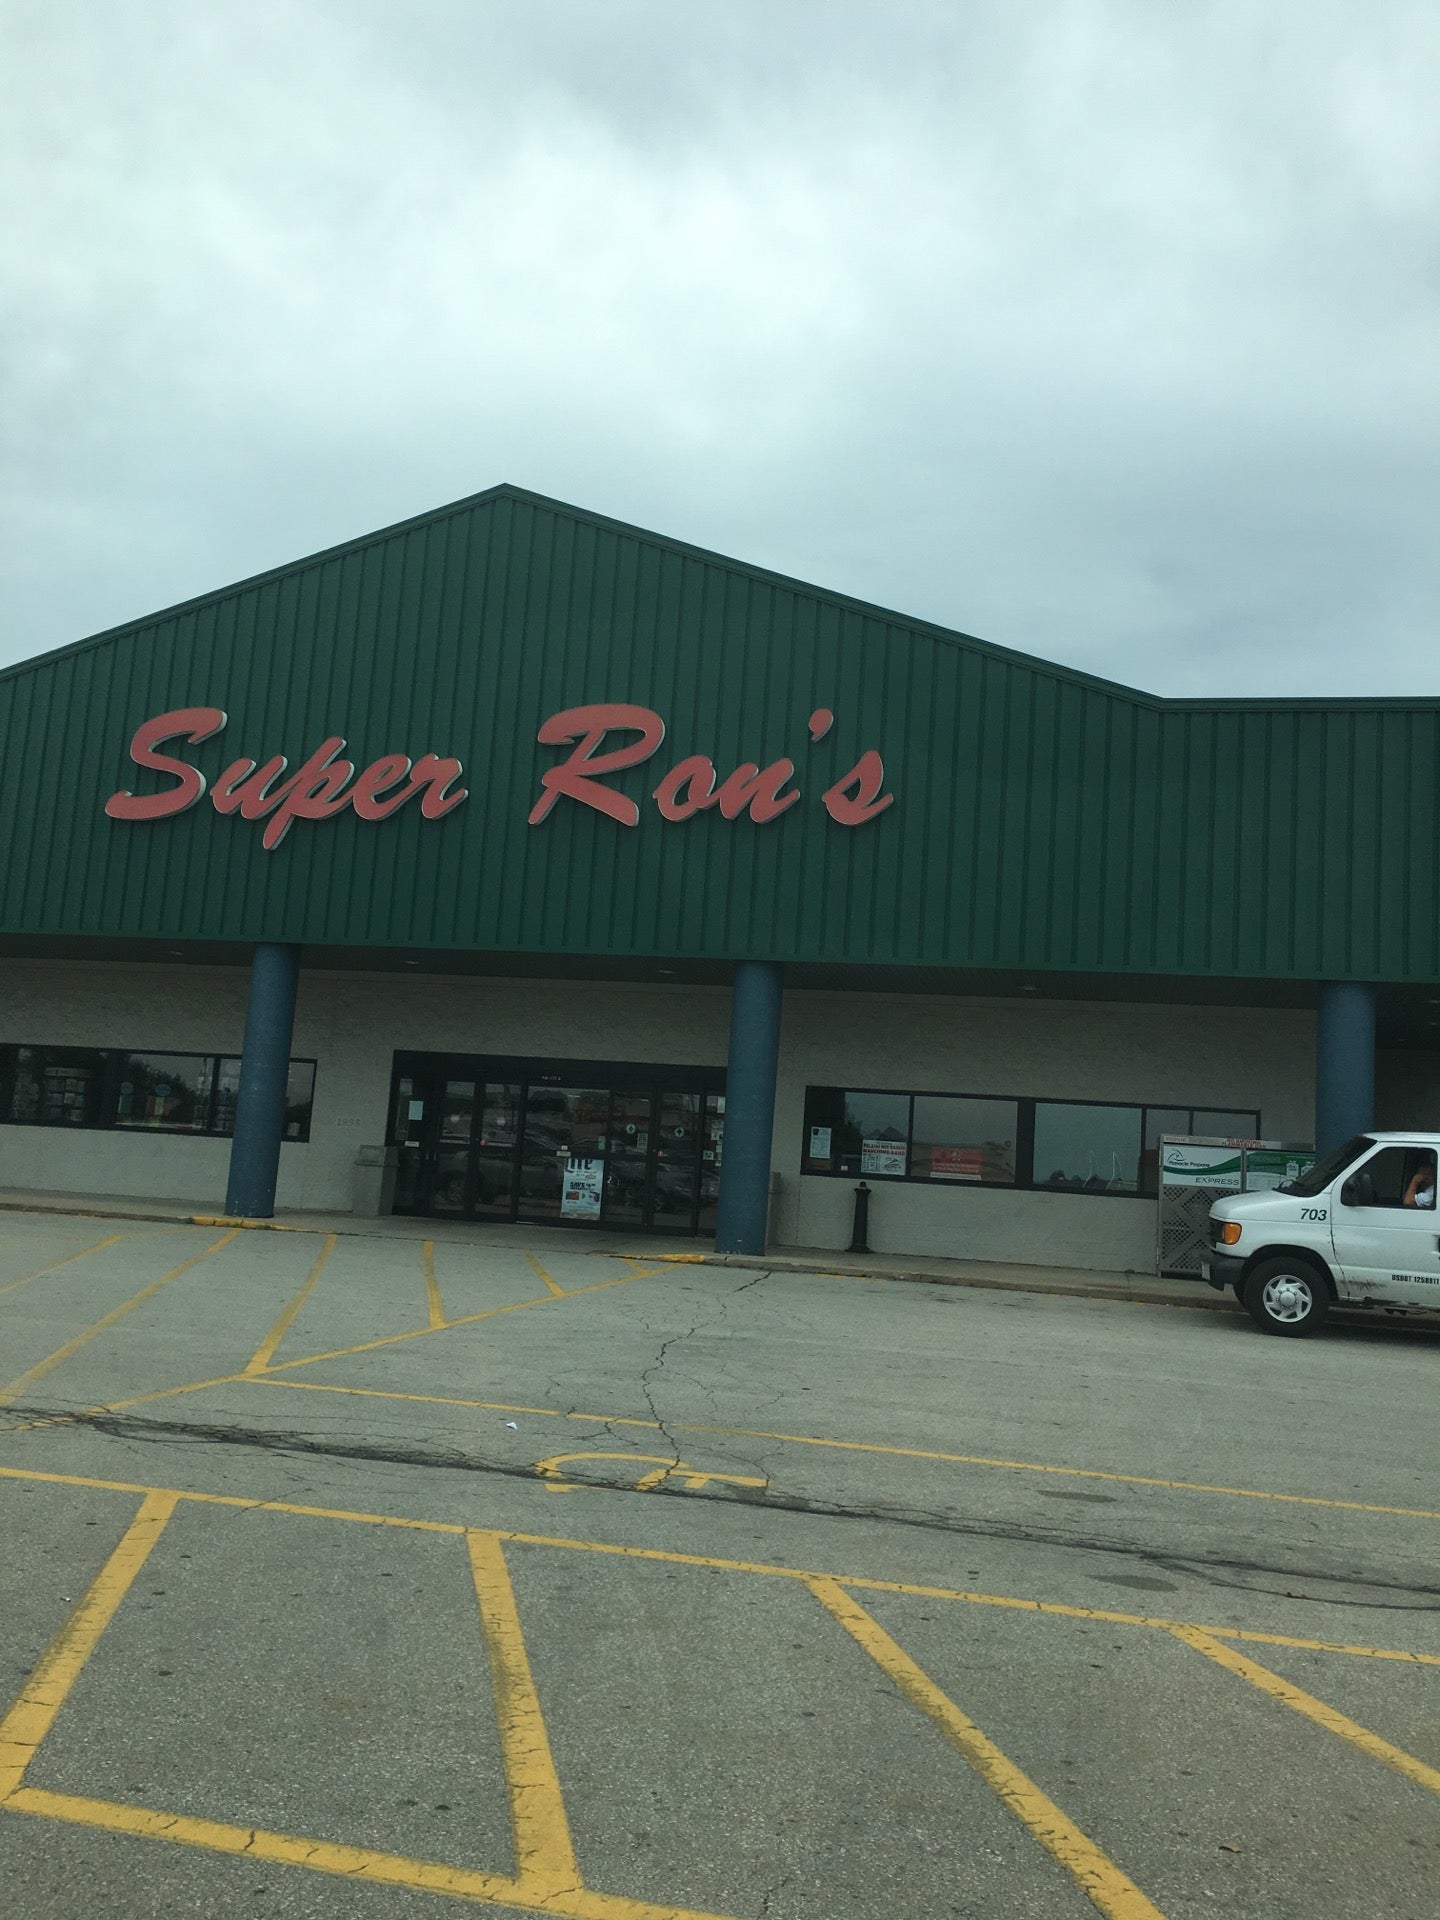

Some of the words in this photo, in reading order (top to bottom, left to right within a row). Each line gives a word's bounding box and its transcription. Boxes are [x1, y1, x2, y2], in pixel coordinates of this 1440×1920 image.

[105, 707, 469, 850] Super
[528, 704, 894, 826] Ron's
[1195, 1176, 1239, 1186] EXPRESS
[1300, 1208, 1327, 1221] 703
